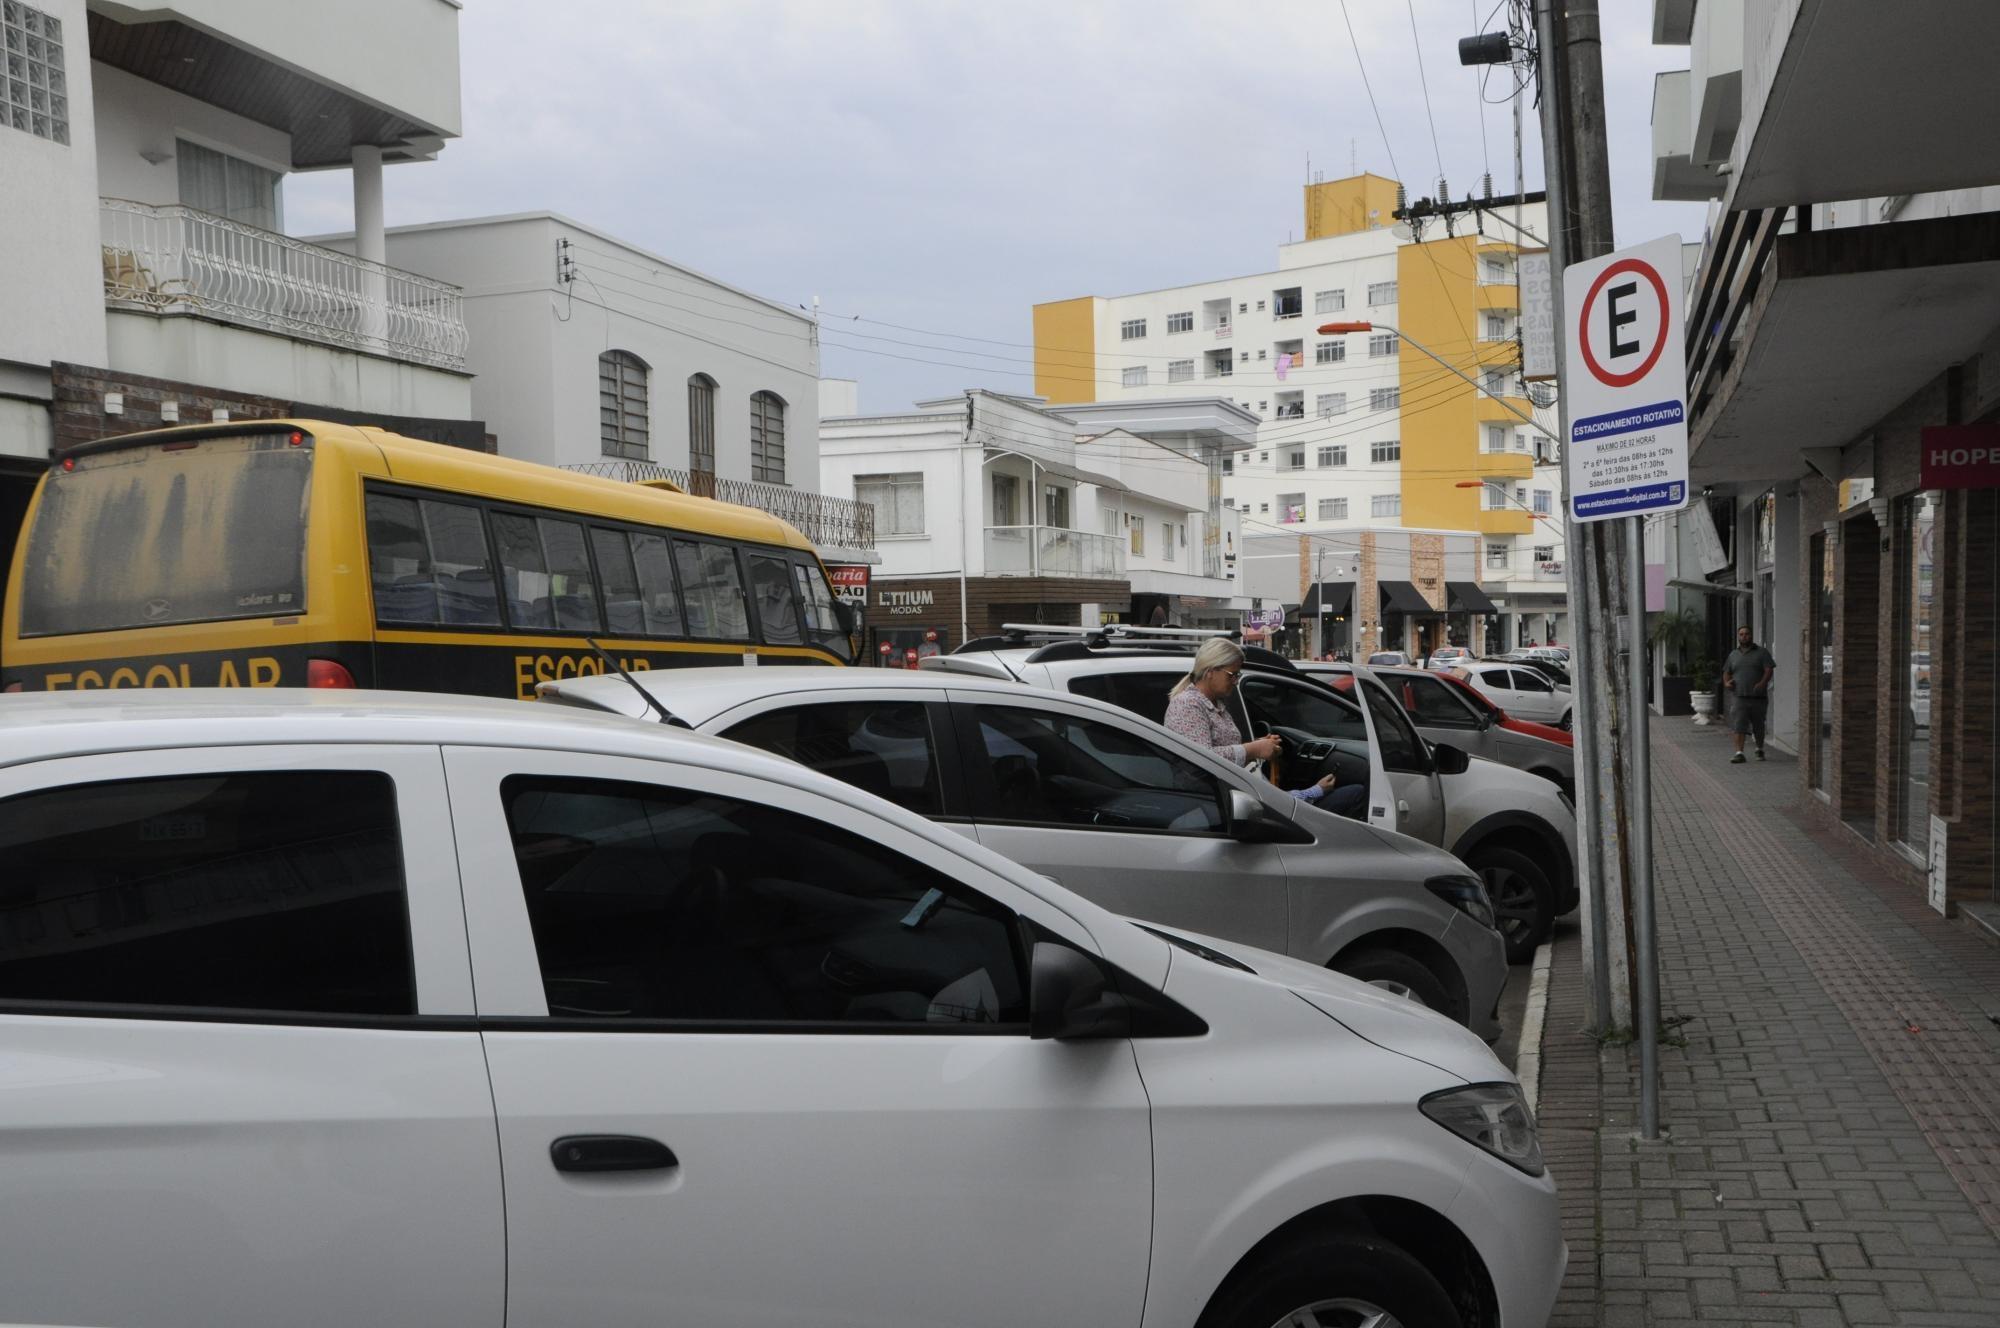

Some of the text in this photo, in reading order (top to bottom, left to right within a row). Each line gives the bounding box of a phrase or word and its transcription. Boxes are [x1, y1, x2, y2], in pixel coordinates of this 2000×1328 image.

[1608, 281, 1640, 359] E
[1574, 407, 1681, 436] ESTACIONAMENTO ROTATIVO
[1620, 440, 1627, 448] DE
[1629, 439, 1635, 447] 02
[1636, 434, 1656, 445] HORAS
[1603, 457, 1618, 466] feira
[1619, 455, 1631, 463] das
[1632, 452, 1647, 460] 08hs
[1658, 447, 1673, 456] 12hs
[1930, 447, 2000, 467] HOPE
[1589, 477, 1613, 488] Sábado
[1614, 475, 1626, 484] das
[1627, 473, 1642, 482] 08hs
[1653, 469, 1668, 479] 12hs
[1592, 469, 1603, 478] das
[1605, 466, 1629, 476] 13:30hs
[1640, 460, 1665, 469] 17:30hs
[1577, 489, 1668, 510] www.estacionamentodigital.com.br
[890, 606, 923, 615] MODAS
